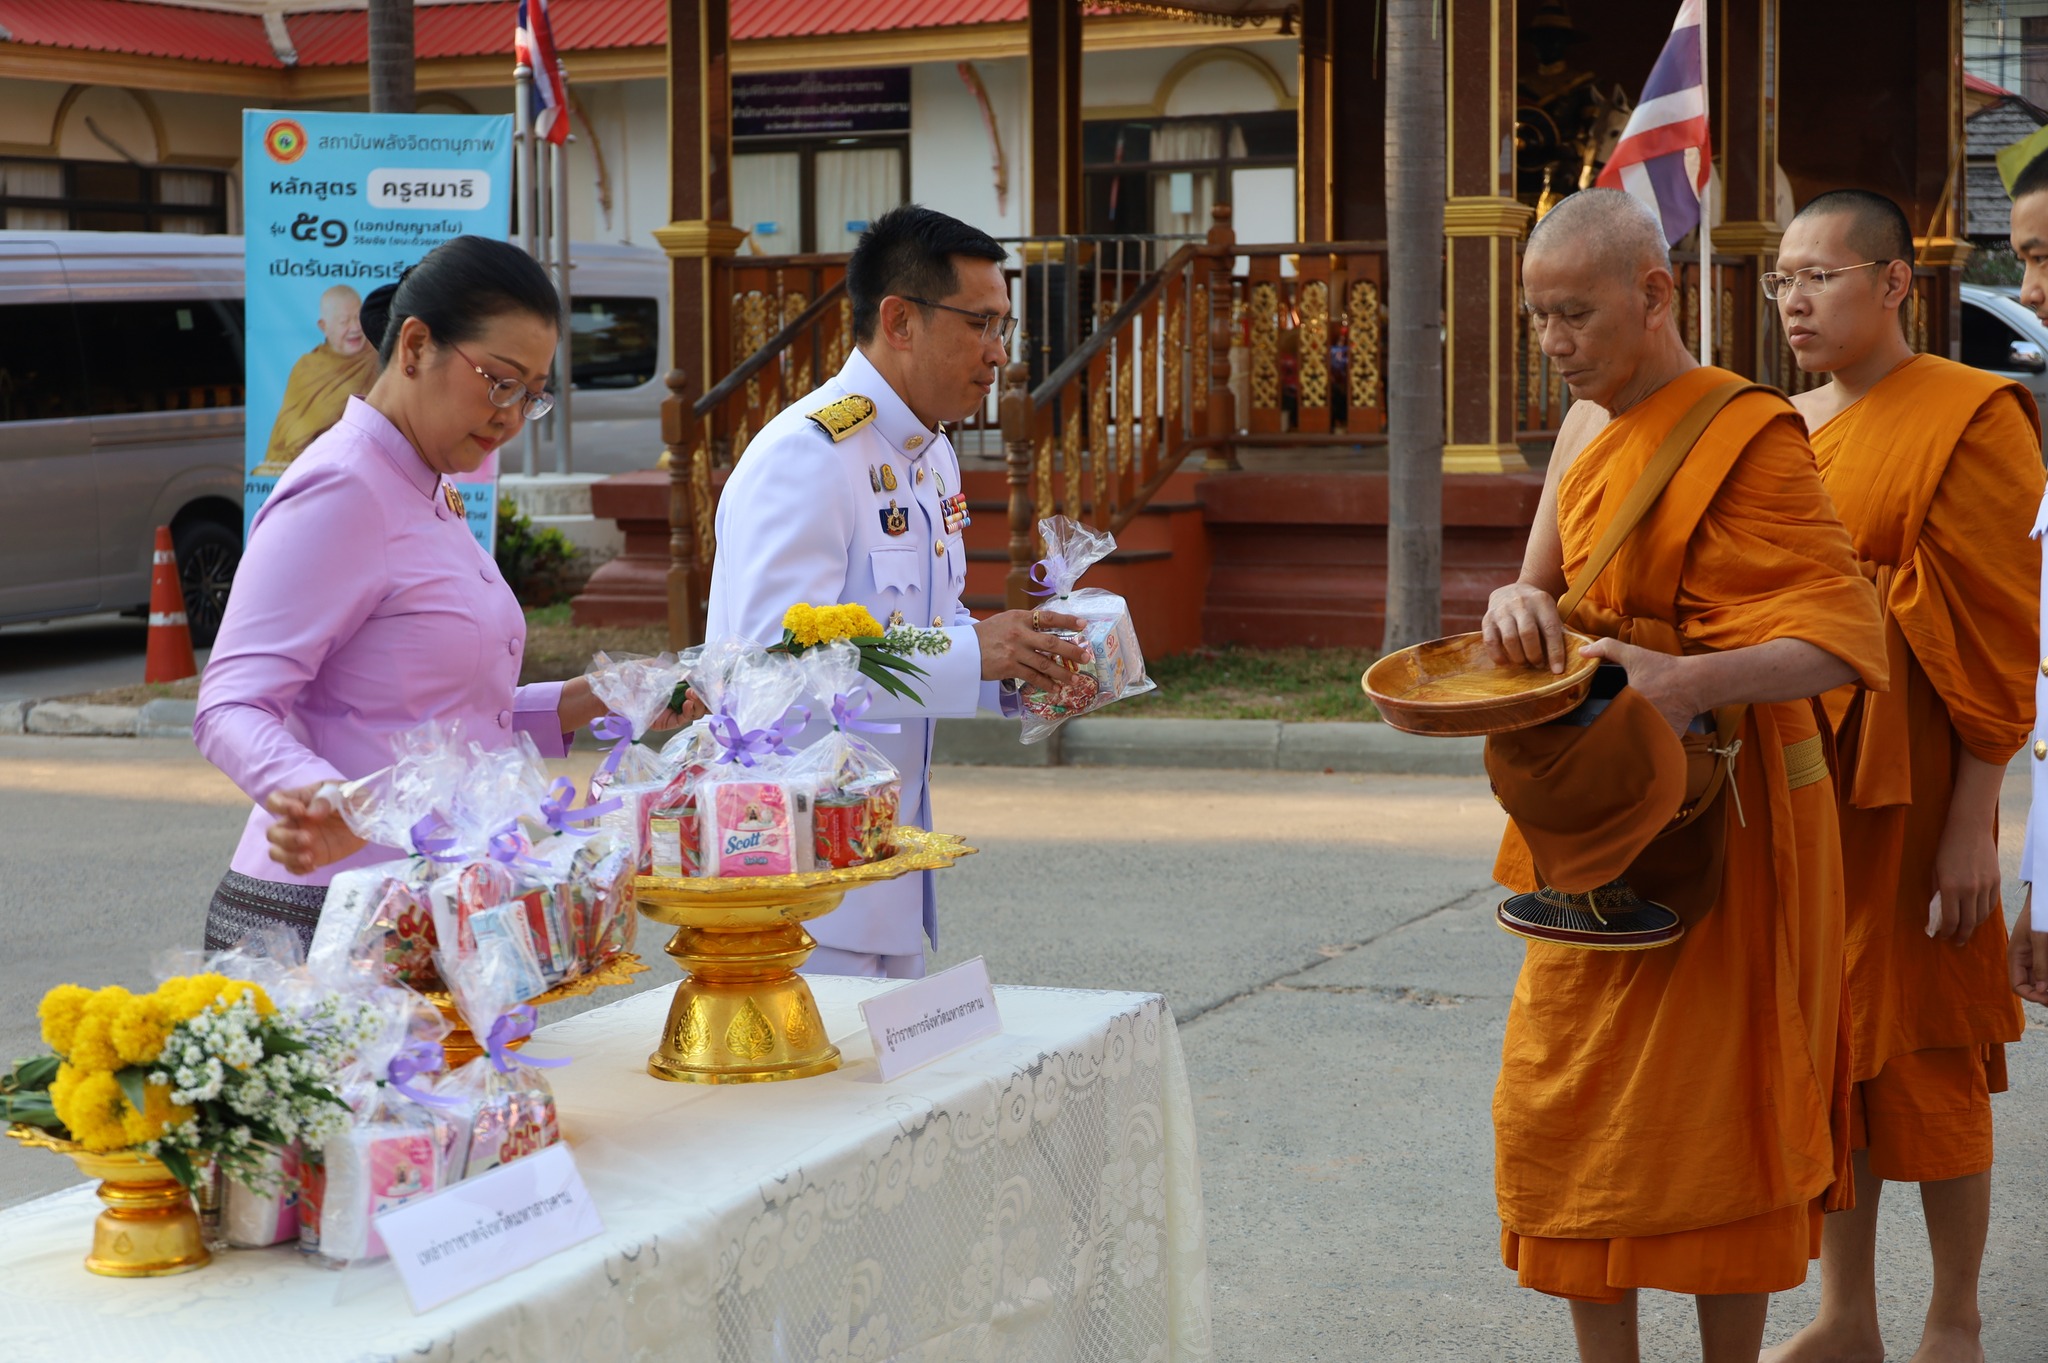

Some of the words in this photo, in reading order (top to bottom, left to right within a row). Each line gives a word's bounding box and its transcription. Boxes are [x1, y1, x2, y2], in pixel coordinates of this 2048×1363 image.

[318, 133, 495, 156] สถาบันพลังจิตตานุภาพ
[270, 176, 357, 201] หลักสูตร
[382, 179, 474, 203] ครูสมาธิ
[270, 221, 286, 237] รุ่น
[290, 212, 348, 248] ๕๑
[269, 258, 413, 279] เปิดรับสมัครเรี
[245, 482, 274, 494] ภาค
[725, 831, 760, 855] Scott
[886, 997, 984, 1052] ผู้ว่าราชการจังหวัดมหาสารคาม
[416, 1190, 574, 1266] เหล่ากาชาดจังหวัดมหาสารคาม
